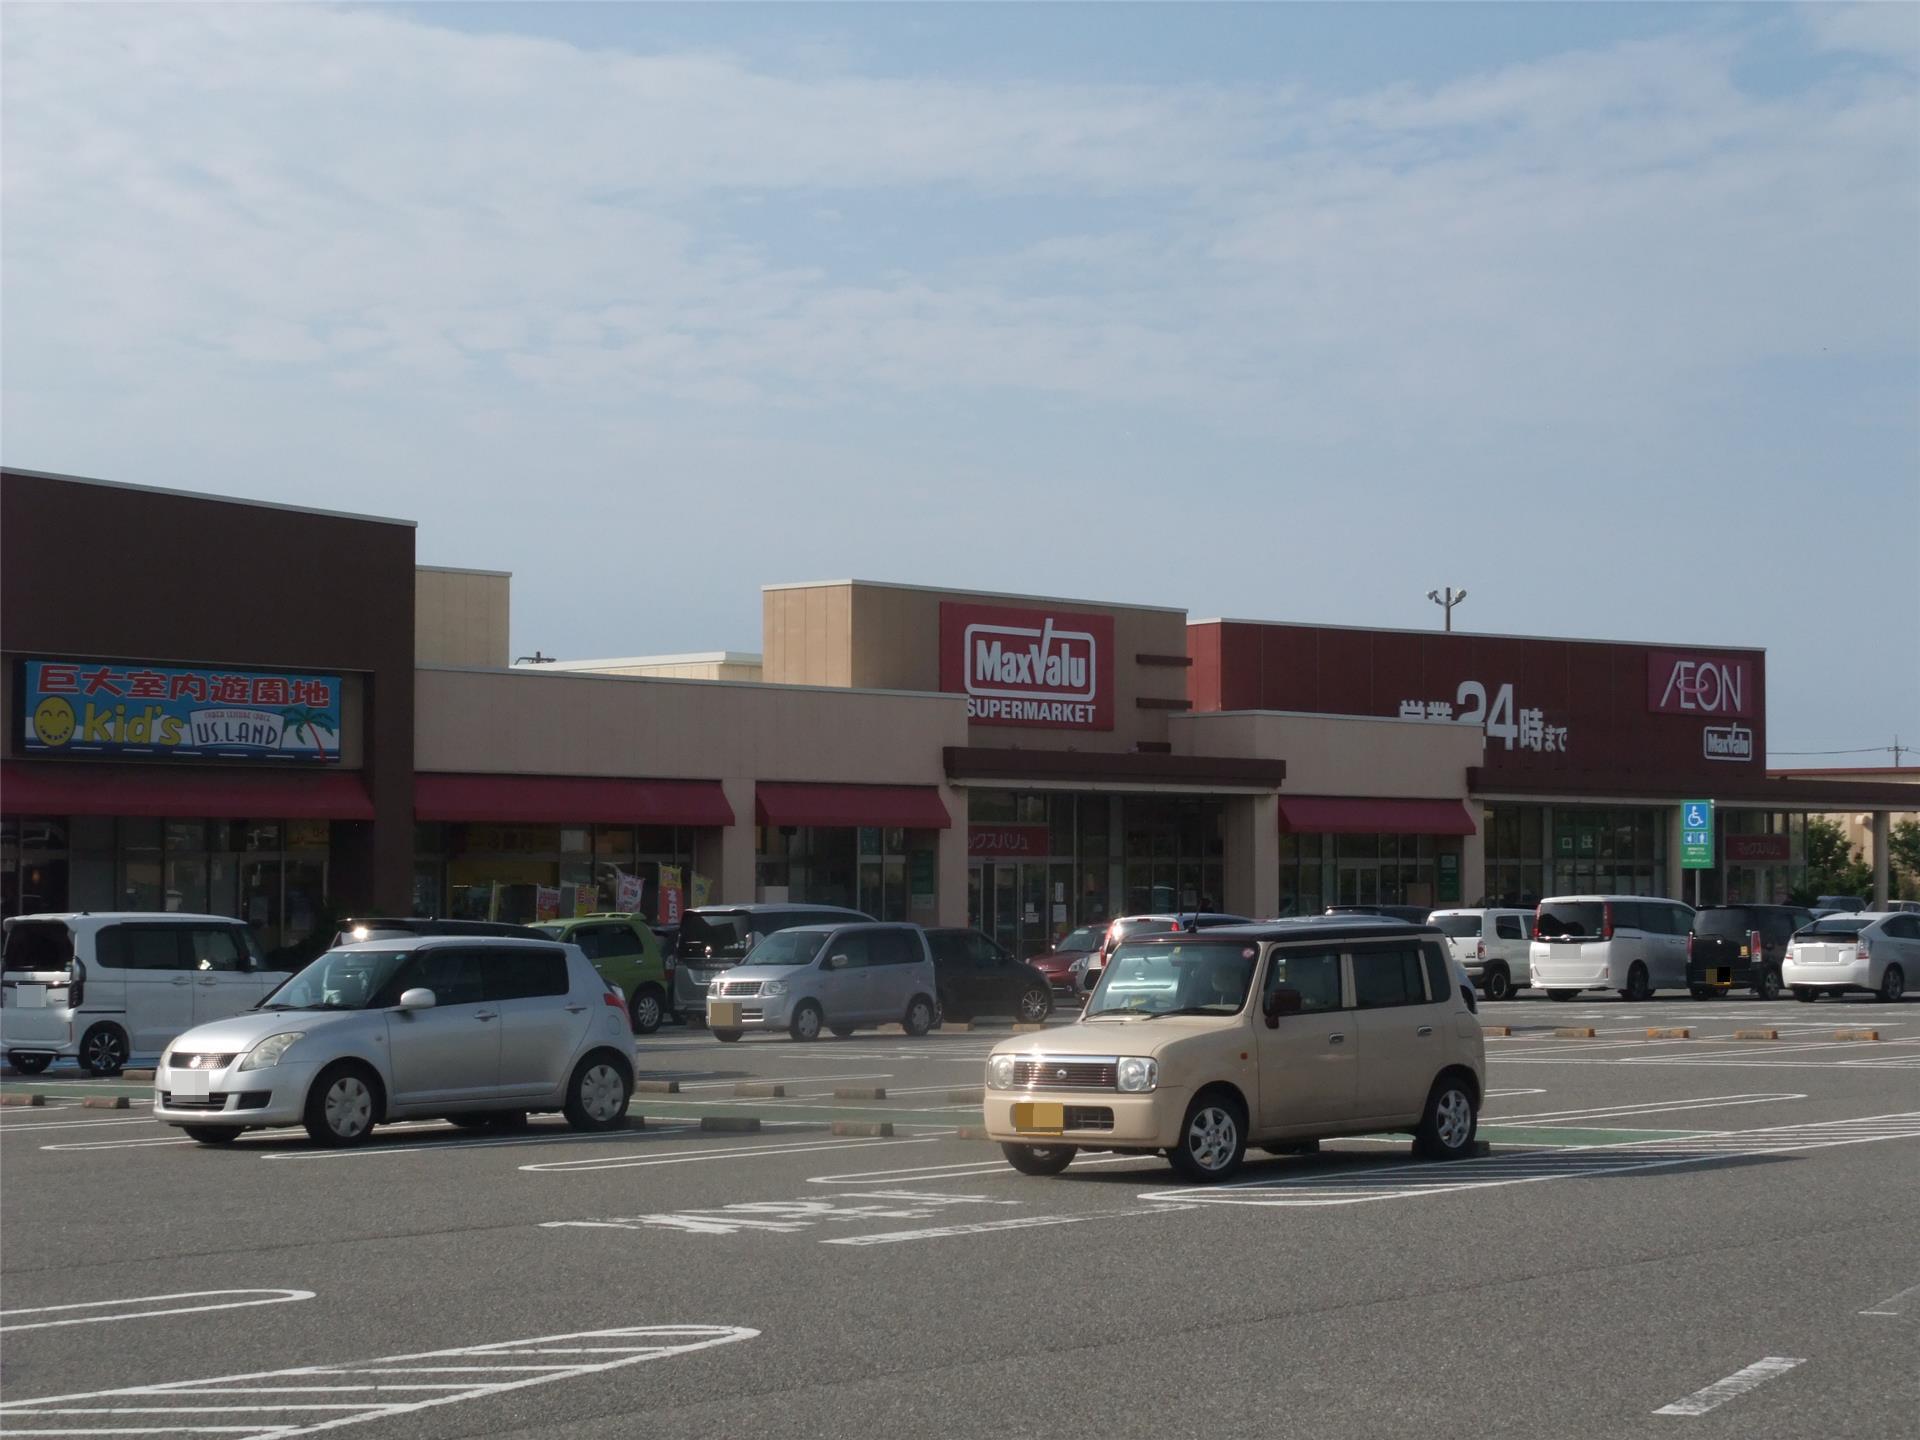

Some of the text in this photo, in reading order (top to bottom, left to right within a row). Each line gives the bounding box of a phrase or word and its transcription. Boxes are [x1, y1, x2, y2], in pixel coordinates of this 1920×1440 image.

[976, 618, 1086, 687] MaxValu
[38, 664, 330, 708] 巨大室内遊園地
[967, 698, 1096, 723] SUPERMARKET
[1708, 722, 1748, 754] MaxValu
